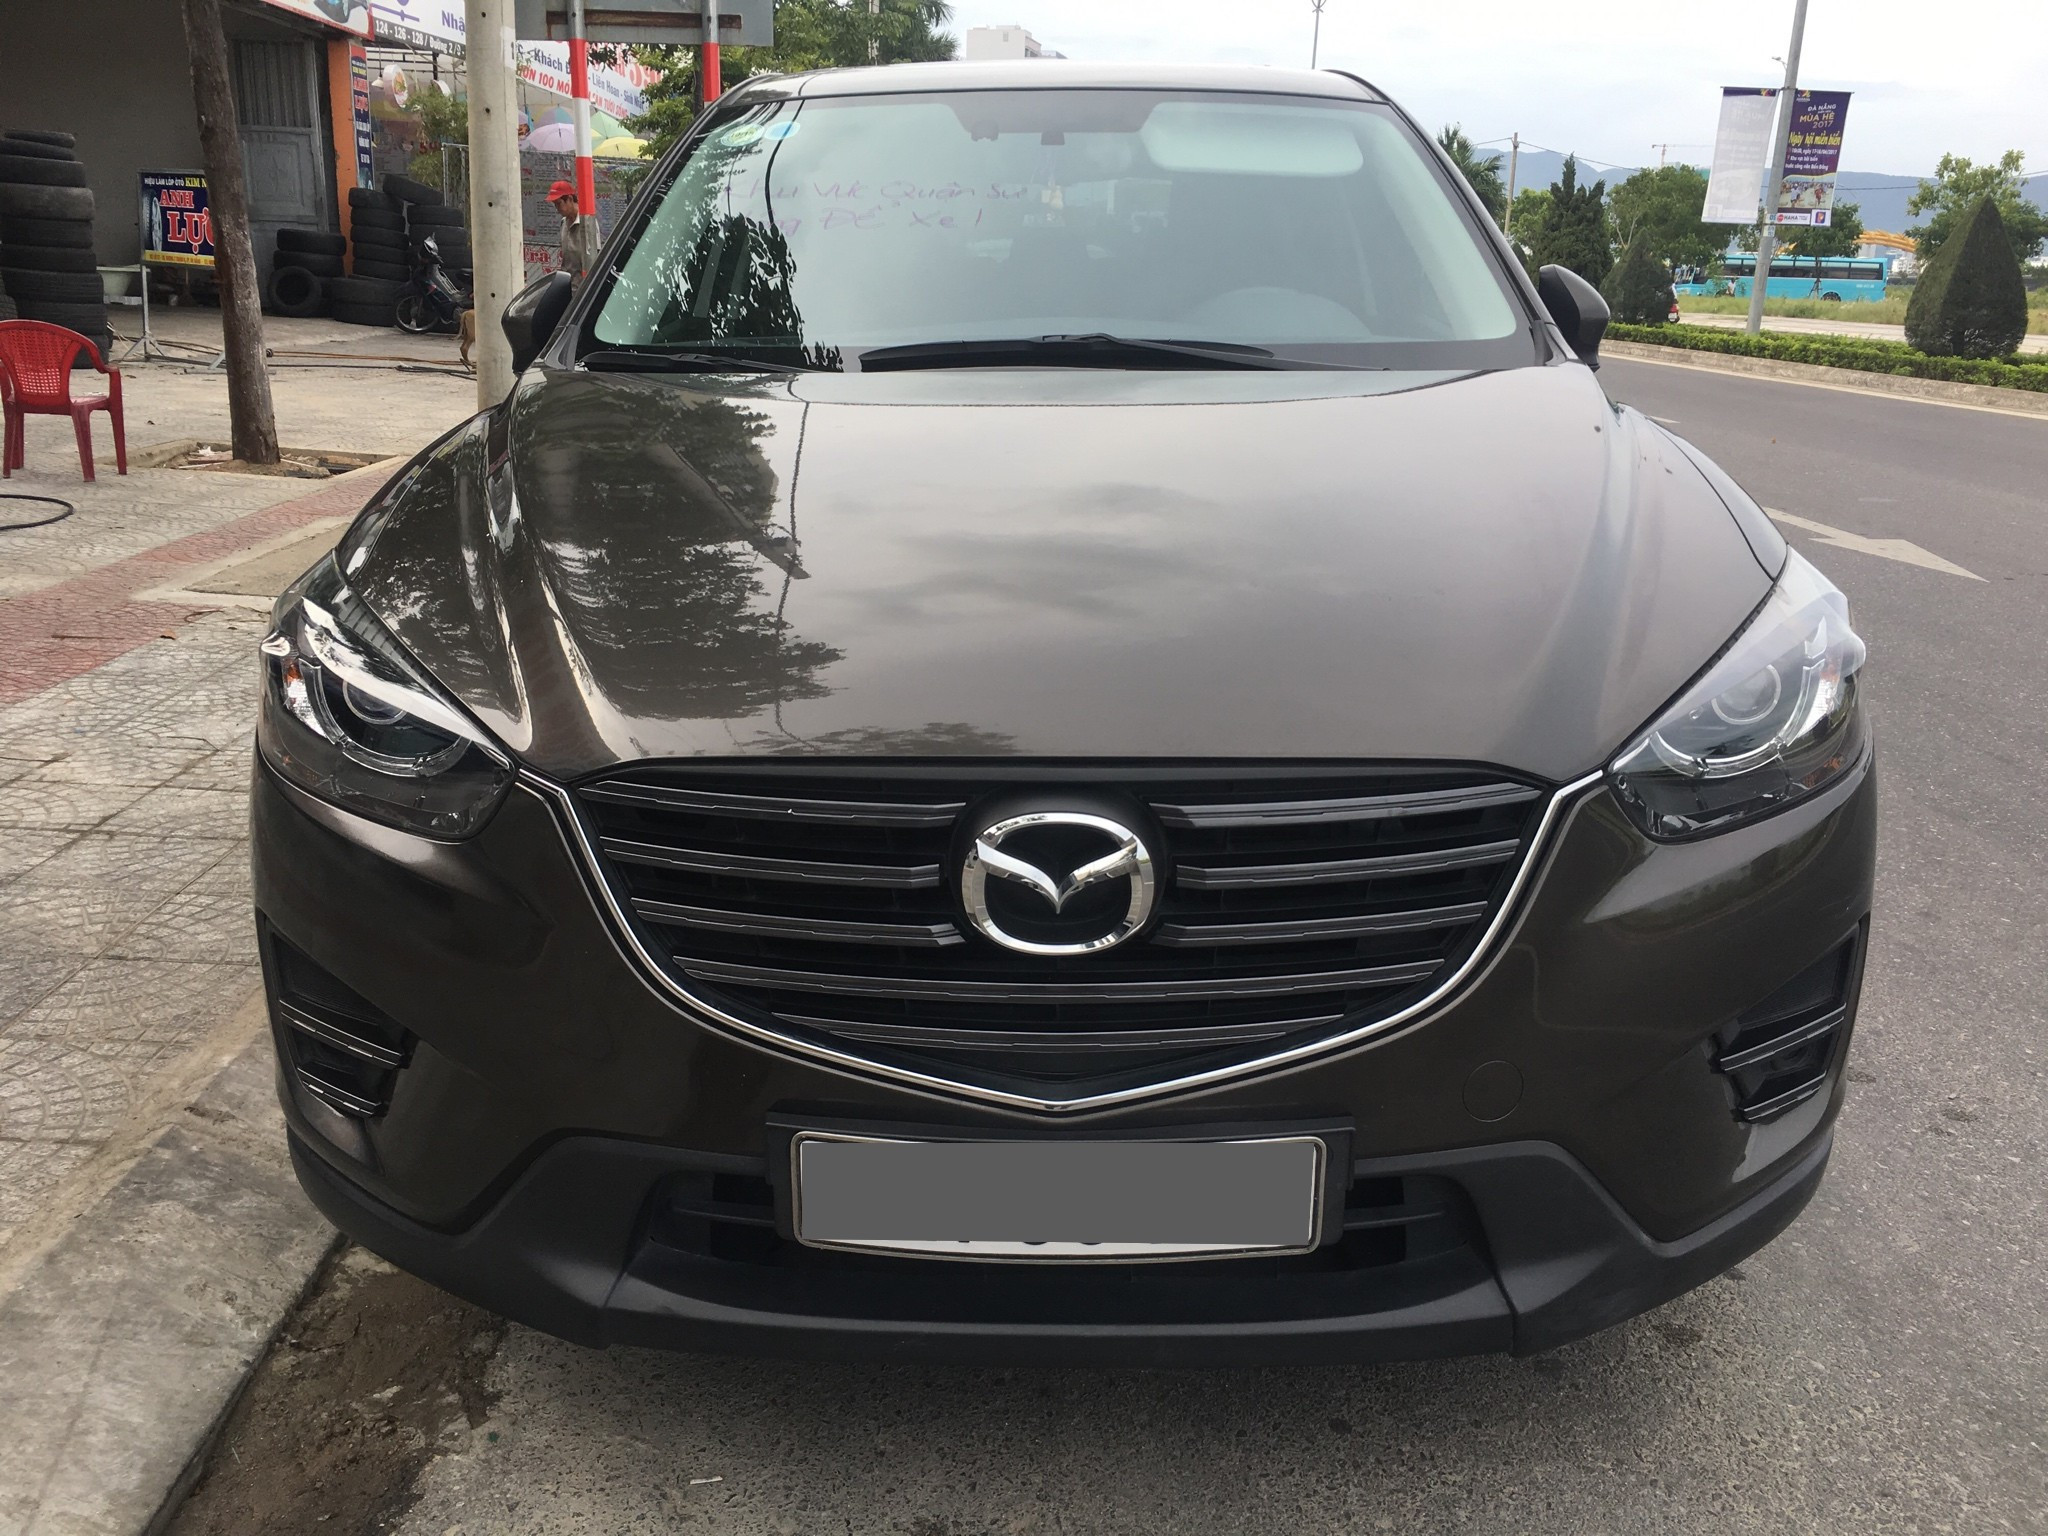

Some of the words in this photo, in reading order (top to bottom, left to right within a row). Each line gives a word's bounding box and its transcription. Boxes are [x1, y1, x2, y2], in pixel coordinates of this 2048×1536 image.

[375, 19, 389, 36] 124
[394, 25, 407, 40] 126
[411, 31, 424, 45] 128
[534, 47, 563, 72] Khách
[538, 70, 554, 89] 100
[556, 77, 572, 96] MÓ
[1812, 120, 1834, 129] 2017
[185, 177, 201, 188] KIM
[160, 189, 195, 209] ANH
